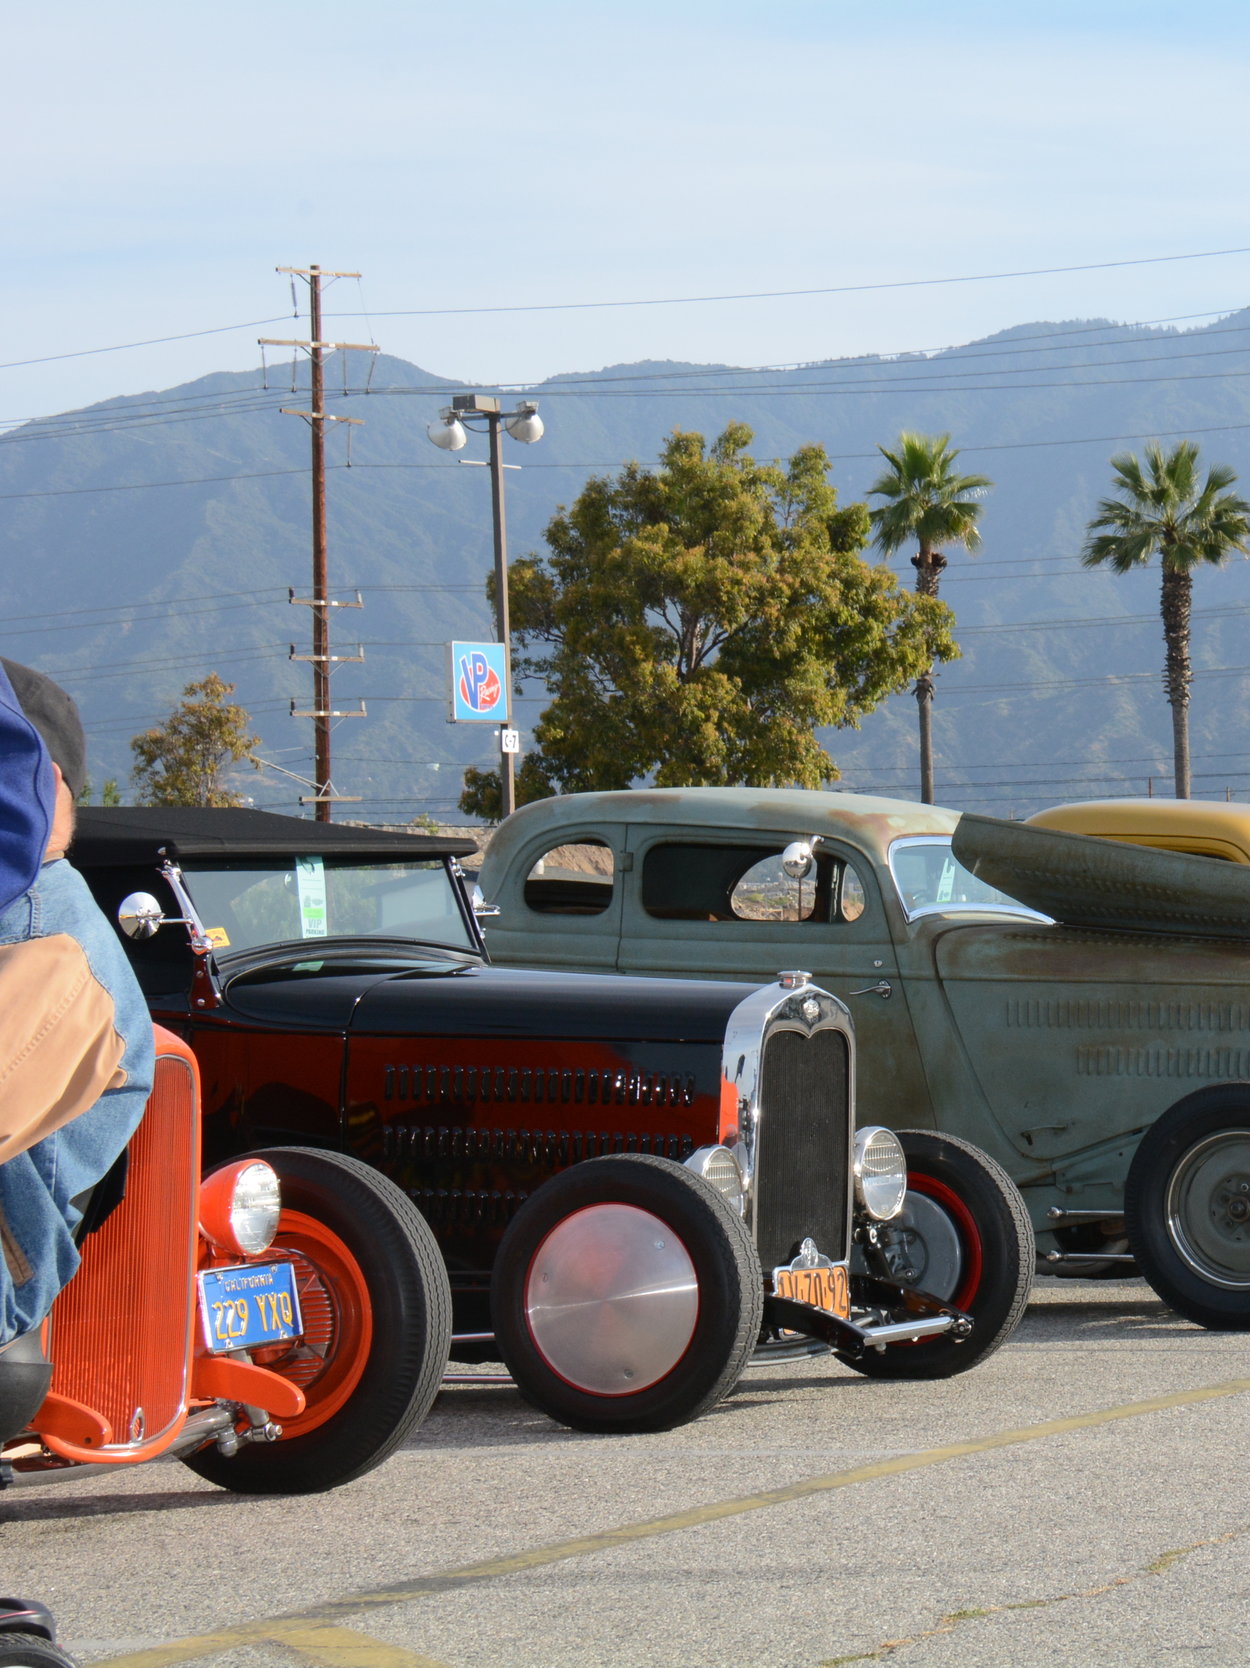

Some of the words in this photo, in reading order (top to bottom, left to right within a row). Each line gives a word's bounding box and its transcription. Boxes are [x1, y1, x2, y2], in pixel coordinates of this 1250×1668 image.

[460, 651, 488, 711] VP
[308, 919, 322, 929] VIP
[224, 1273, 274, 1293] CALIFORNIA
[211, 1298, 249, 1340] 229
[254, 1291, 294, 1332] YXQ
